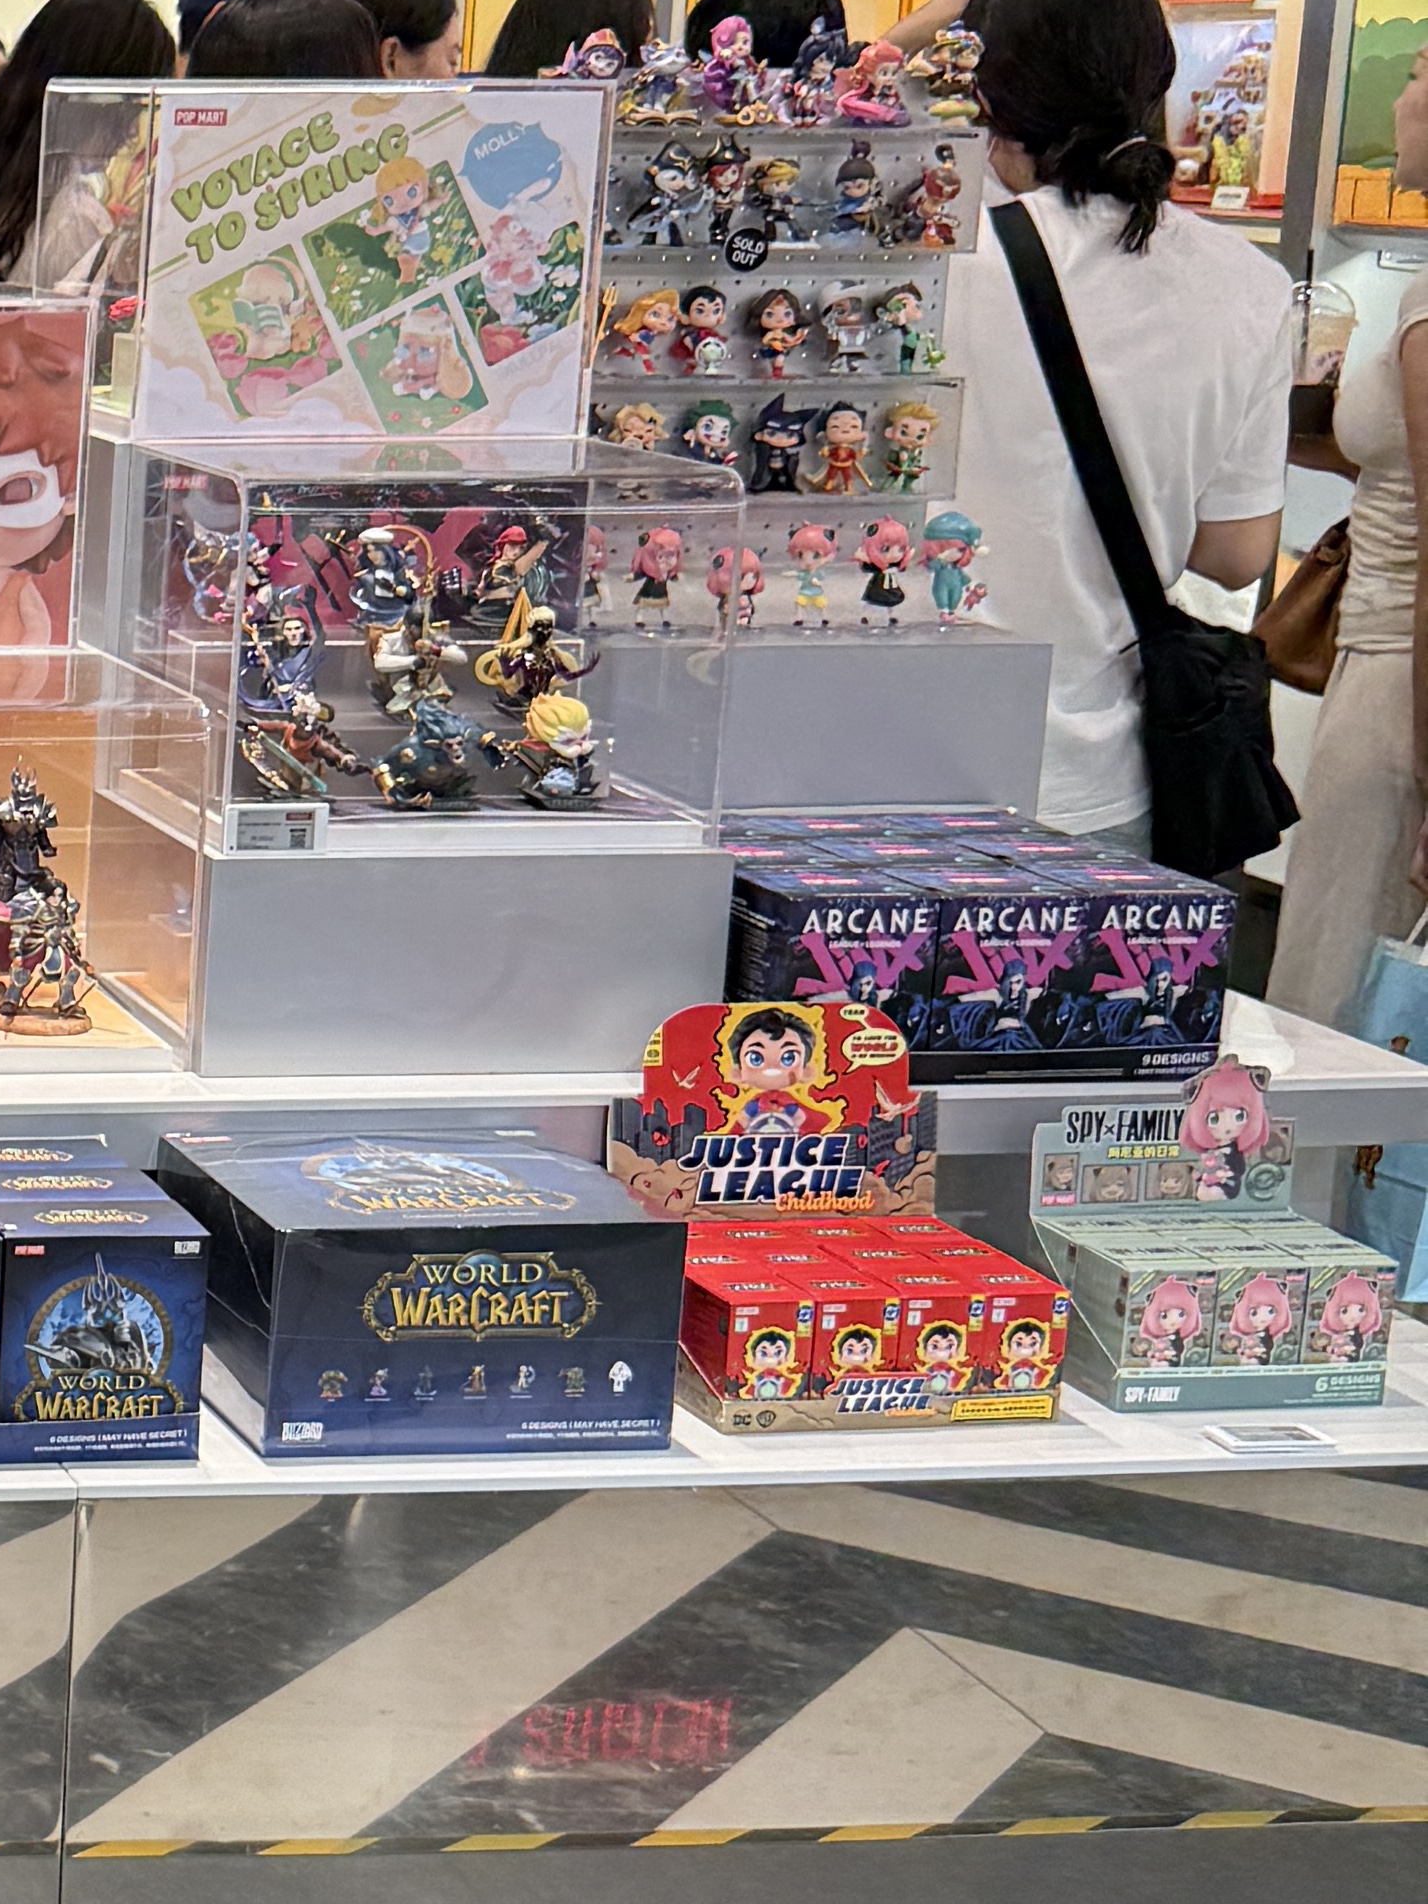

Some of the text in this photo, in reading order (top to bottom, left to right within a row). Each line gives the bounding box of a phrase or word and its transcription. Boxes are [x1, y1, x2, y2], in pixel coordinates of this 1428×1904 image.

[175, 110, 225, 125] POP MART
[473, 123, 527, 161] MOLLY
[170, 111, 340, 222] VOYAGE
[186, 123, 411, 264] TO SPRING
[731, 250, 760, 266] OUT
[732, 237, 765, 254] SOLD
[801, 906, 931, 936] ARCANE
[954, 904, 1080, 934] ARCANE
[1101, 903, 1226, 932] ARCANE
[1152, 1052, 1210, 1066] DESIGNS
[678, 1135, 850, 1171] JUSTICE
[696, 1166, 865, 1204] LEAGUE
[775, 1190, 875, 1213] Childhood
[423, 1262, 543, 1287] WORLD
[390, 1286, 571, 1329] WARCRAFT
[58, 1373, 145, 1393] WORLD
[830, 1378, 928, 1396] JUSTICE
[1315, 1377, 1328, 1392] 6
[35, 1391, 164, 1421] WARCRAFT
[837, 1396, 931, 1413] LEAGUE
